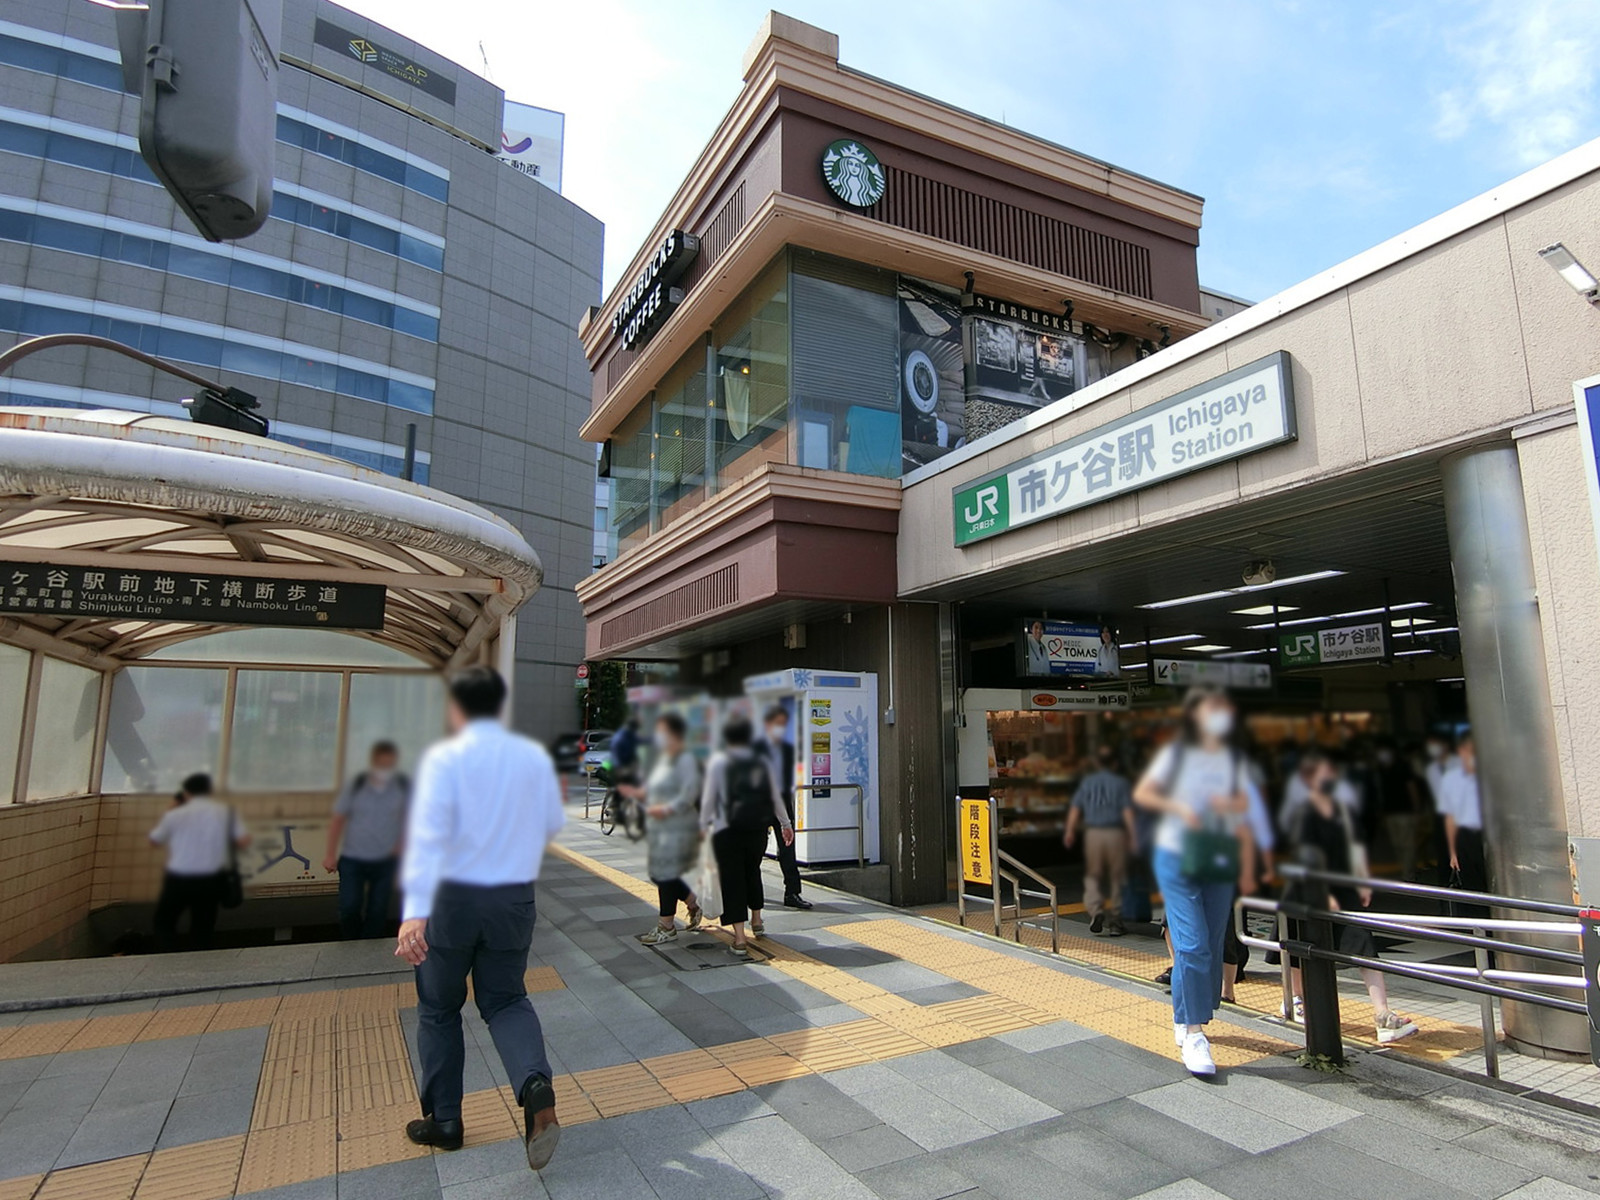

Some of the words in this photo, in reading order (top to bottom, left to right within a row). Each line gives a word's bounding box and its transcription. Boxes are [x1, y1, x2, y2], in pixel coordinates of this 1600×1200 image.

[387, 66, 422, 84] ICHIGAYA
[405, 64, 428, 78] AP
[612, 229, 675, 335] STARBUCKS
[622, 282, 662, 351] COFFEE
[976, 297, 1070, 331] STARBUCKS
[1168, 384, 1267, 436] Ichigaya
[1171, 421, 1254, 464] Station
[964, 485, 999, 524] JR
[969, 519, 996, 534] JR東日本
[79, 601, 132, 613] Shinjuku
[136, 605, 162, 614] Line
[81, 591, 144, 604] Yurakucho
[148, 595, 173, 605] Line
[237, 599, 289, 611] Namboku
[295, 603, 318, 612] Line
[1063, 647, 1098, 658] TOMAS
[1284, 634, 1316, 656] JR
[1323, 648, 1353, 659] Ichigaya
[1355, 645, 1380, 656] Station
[969, 804, 982, 878] 階段注意
